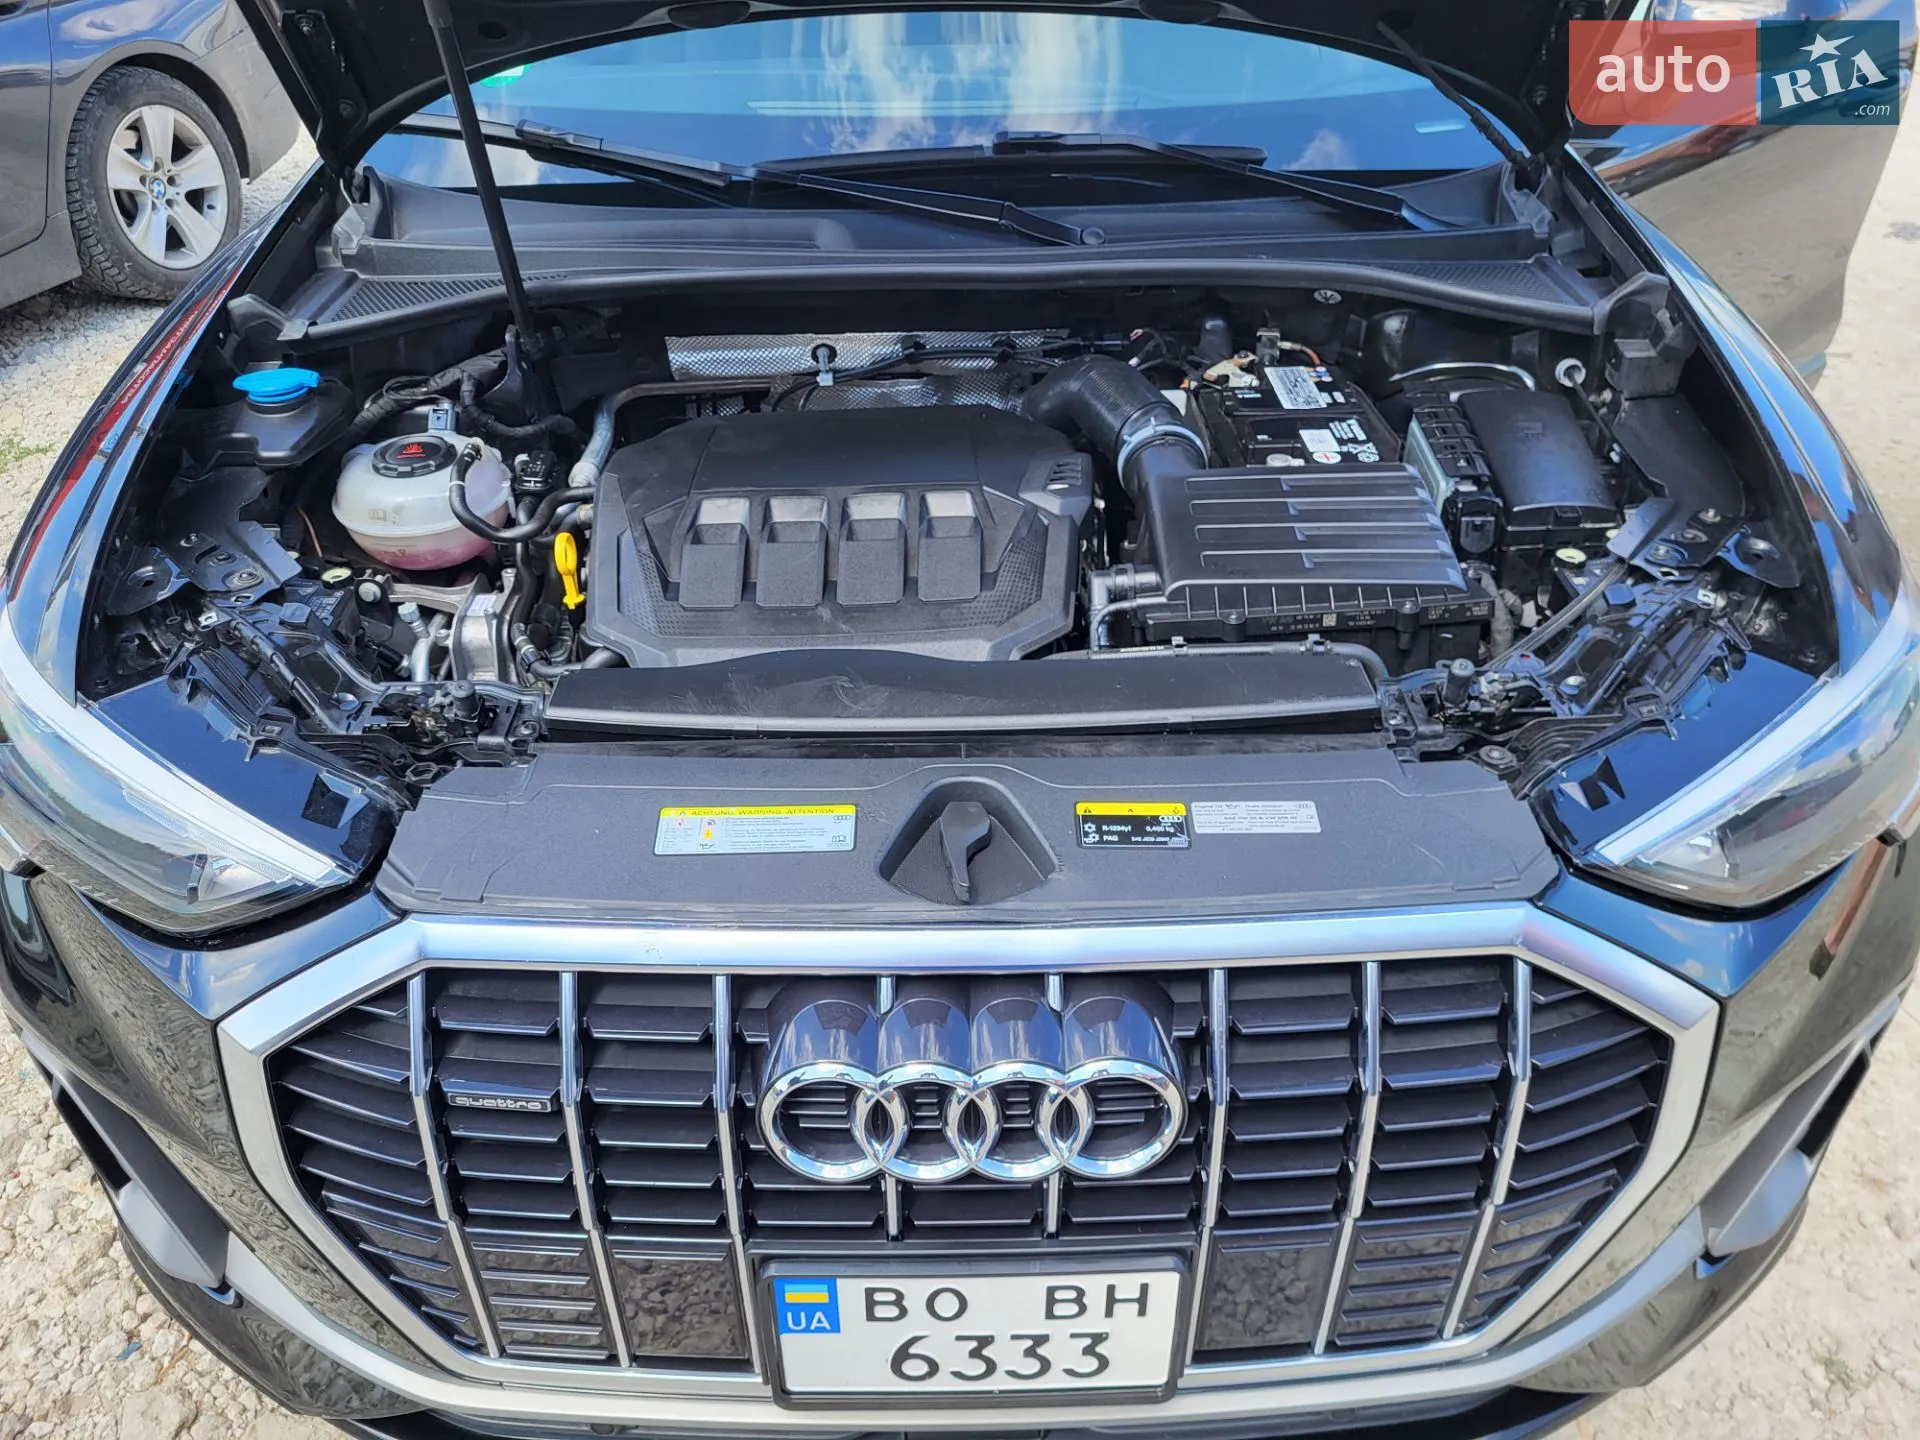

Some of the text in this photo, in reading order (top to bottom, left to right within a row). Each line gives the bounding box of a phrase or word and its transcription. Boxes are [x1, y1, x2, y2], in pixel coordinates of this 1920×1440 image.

[738, 808, 782, 816] WARNING
[784, 807, 836, 816] ATTENTION
[455, 1096, 542, 1110] quattro
[864, 1282, 1149, 1322] BO BH
[787, 1310, 831, 1331] UA
[889, 1331, 1111, 1382] 6333
